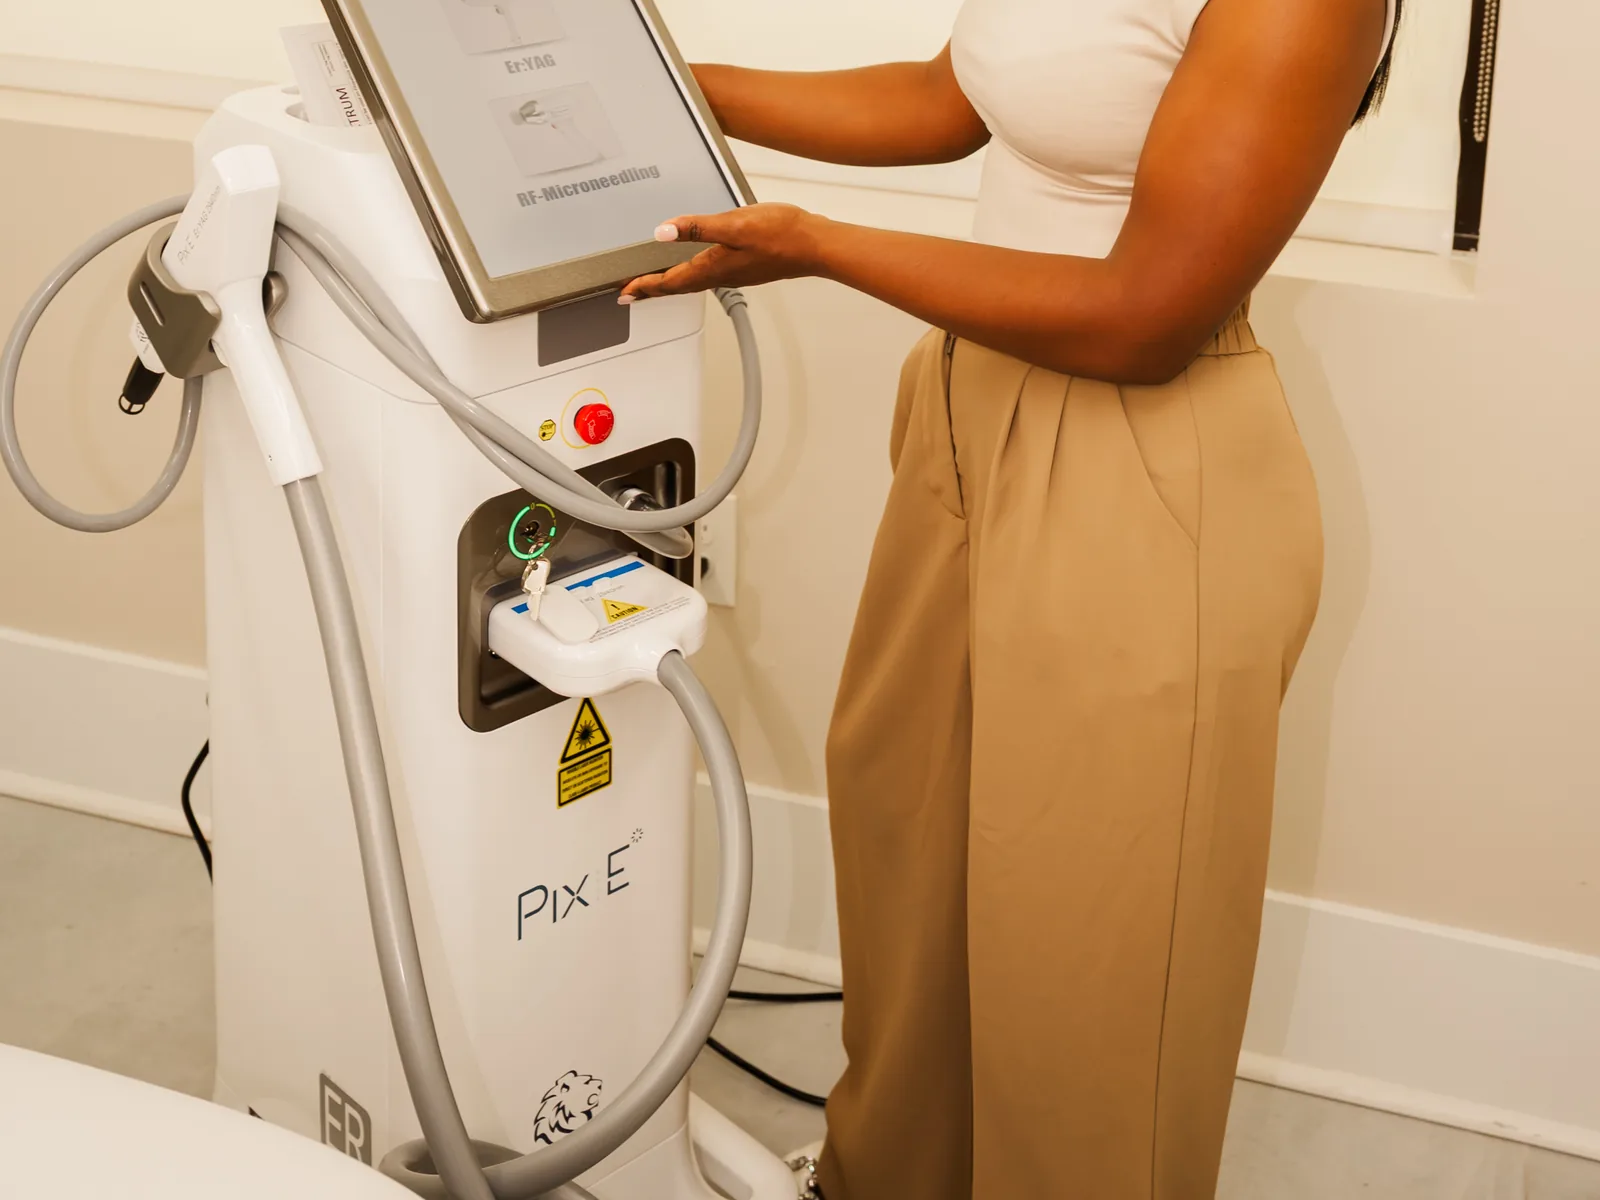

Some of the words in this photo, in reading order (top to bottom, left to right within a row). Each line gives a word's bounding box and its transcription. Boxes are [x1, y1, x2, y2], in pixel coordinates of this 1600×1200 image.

[504, 53, 557, 74] Er:YAG
[336, 87, 361, 127] TRUM
[516, 164, 661, 208] RF-Microneedling
[611, 606, 639, 620] CAUTION
[324, 1084, 365, 1162] ER
